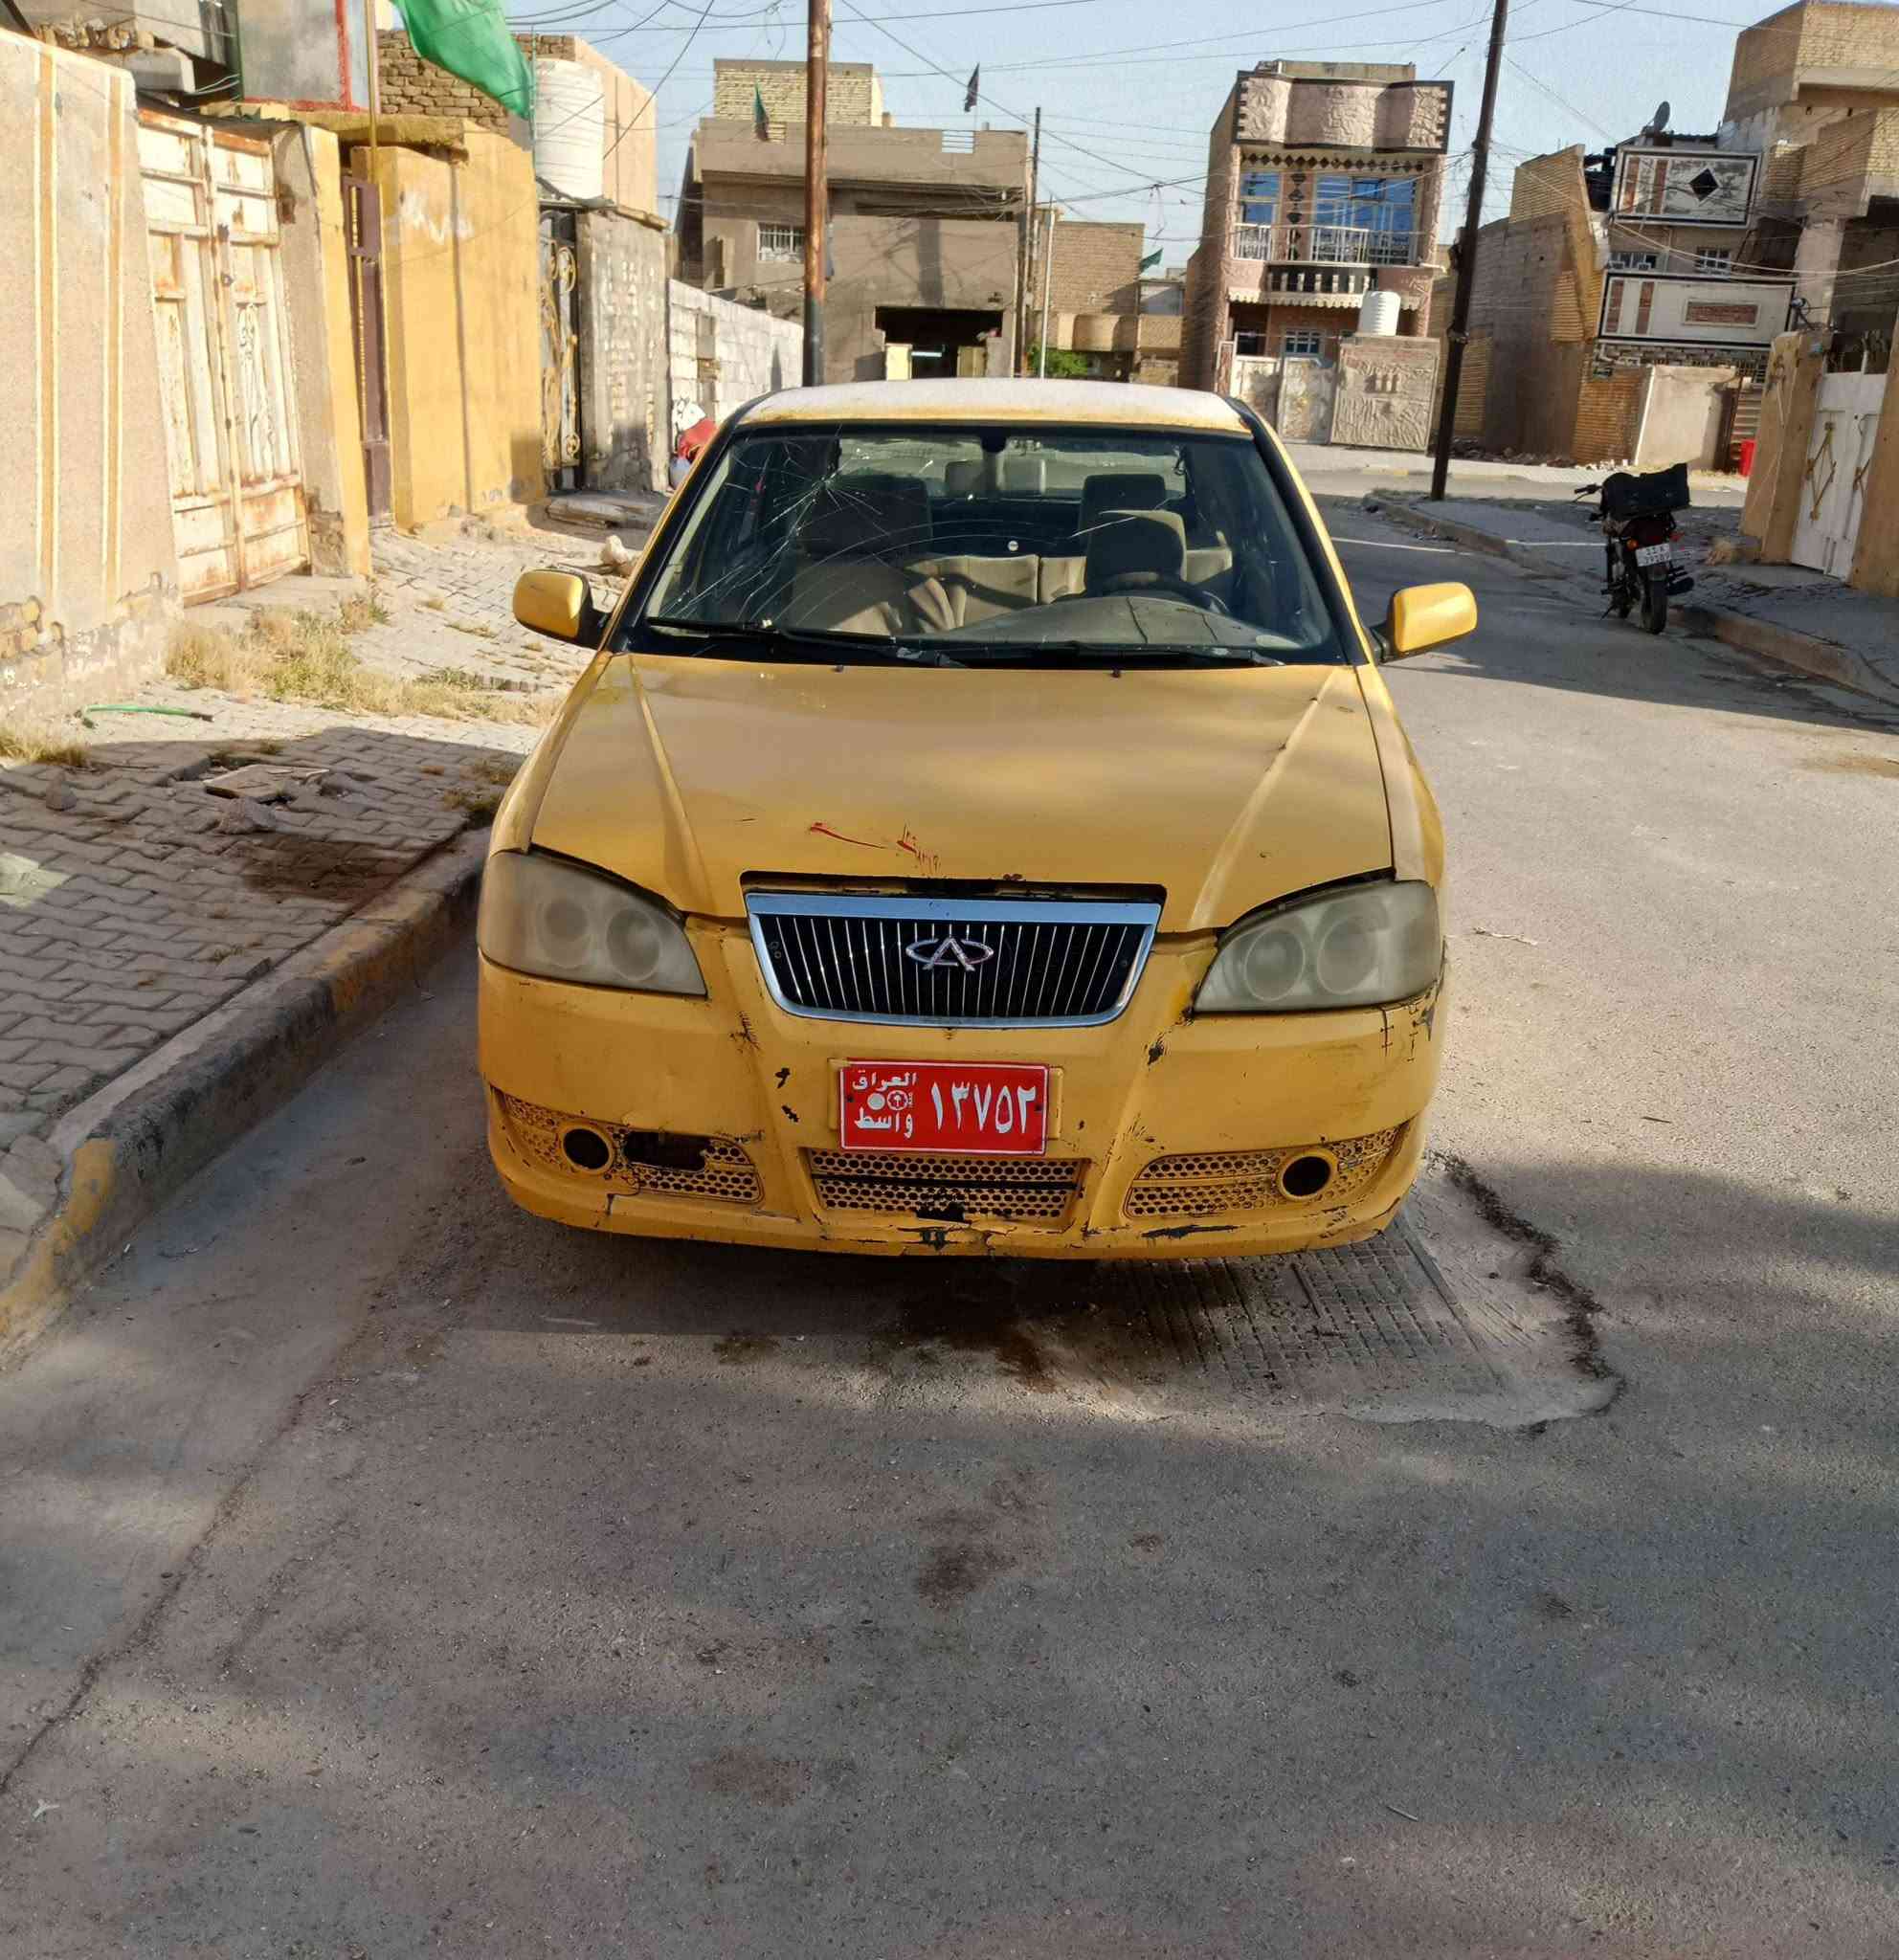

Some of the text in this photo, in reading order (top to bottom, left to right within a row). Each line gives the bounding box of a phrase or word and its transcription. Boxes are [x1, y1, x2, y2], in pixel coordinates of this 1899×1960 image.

[852, 1069, 917, 1091] العراق
[854, 1106, 913, 1139] واسط
[930, 1081, 1037, 1134] ١٣٧٥٢
